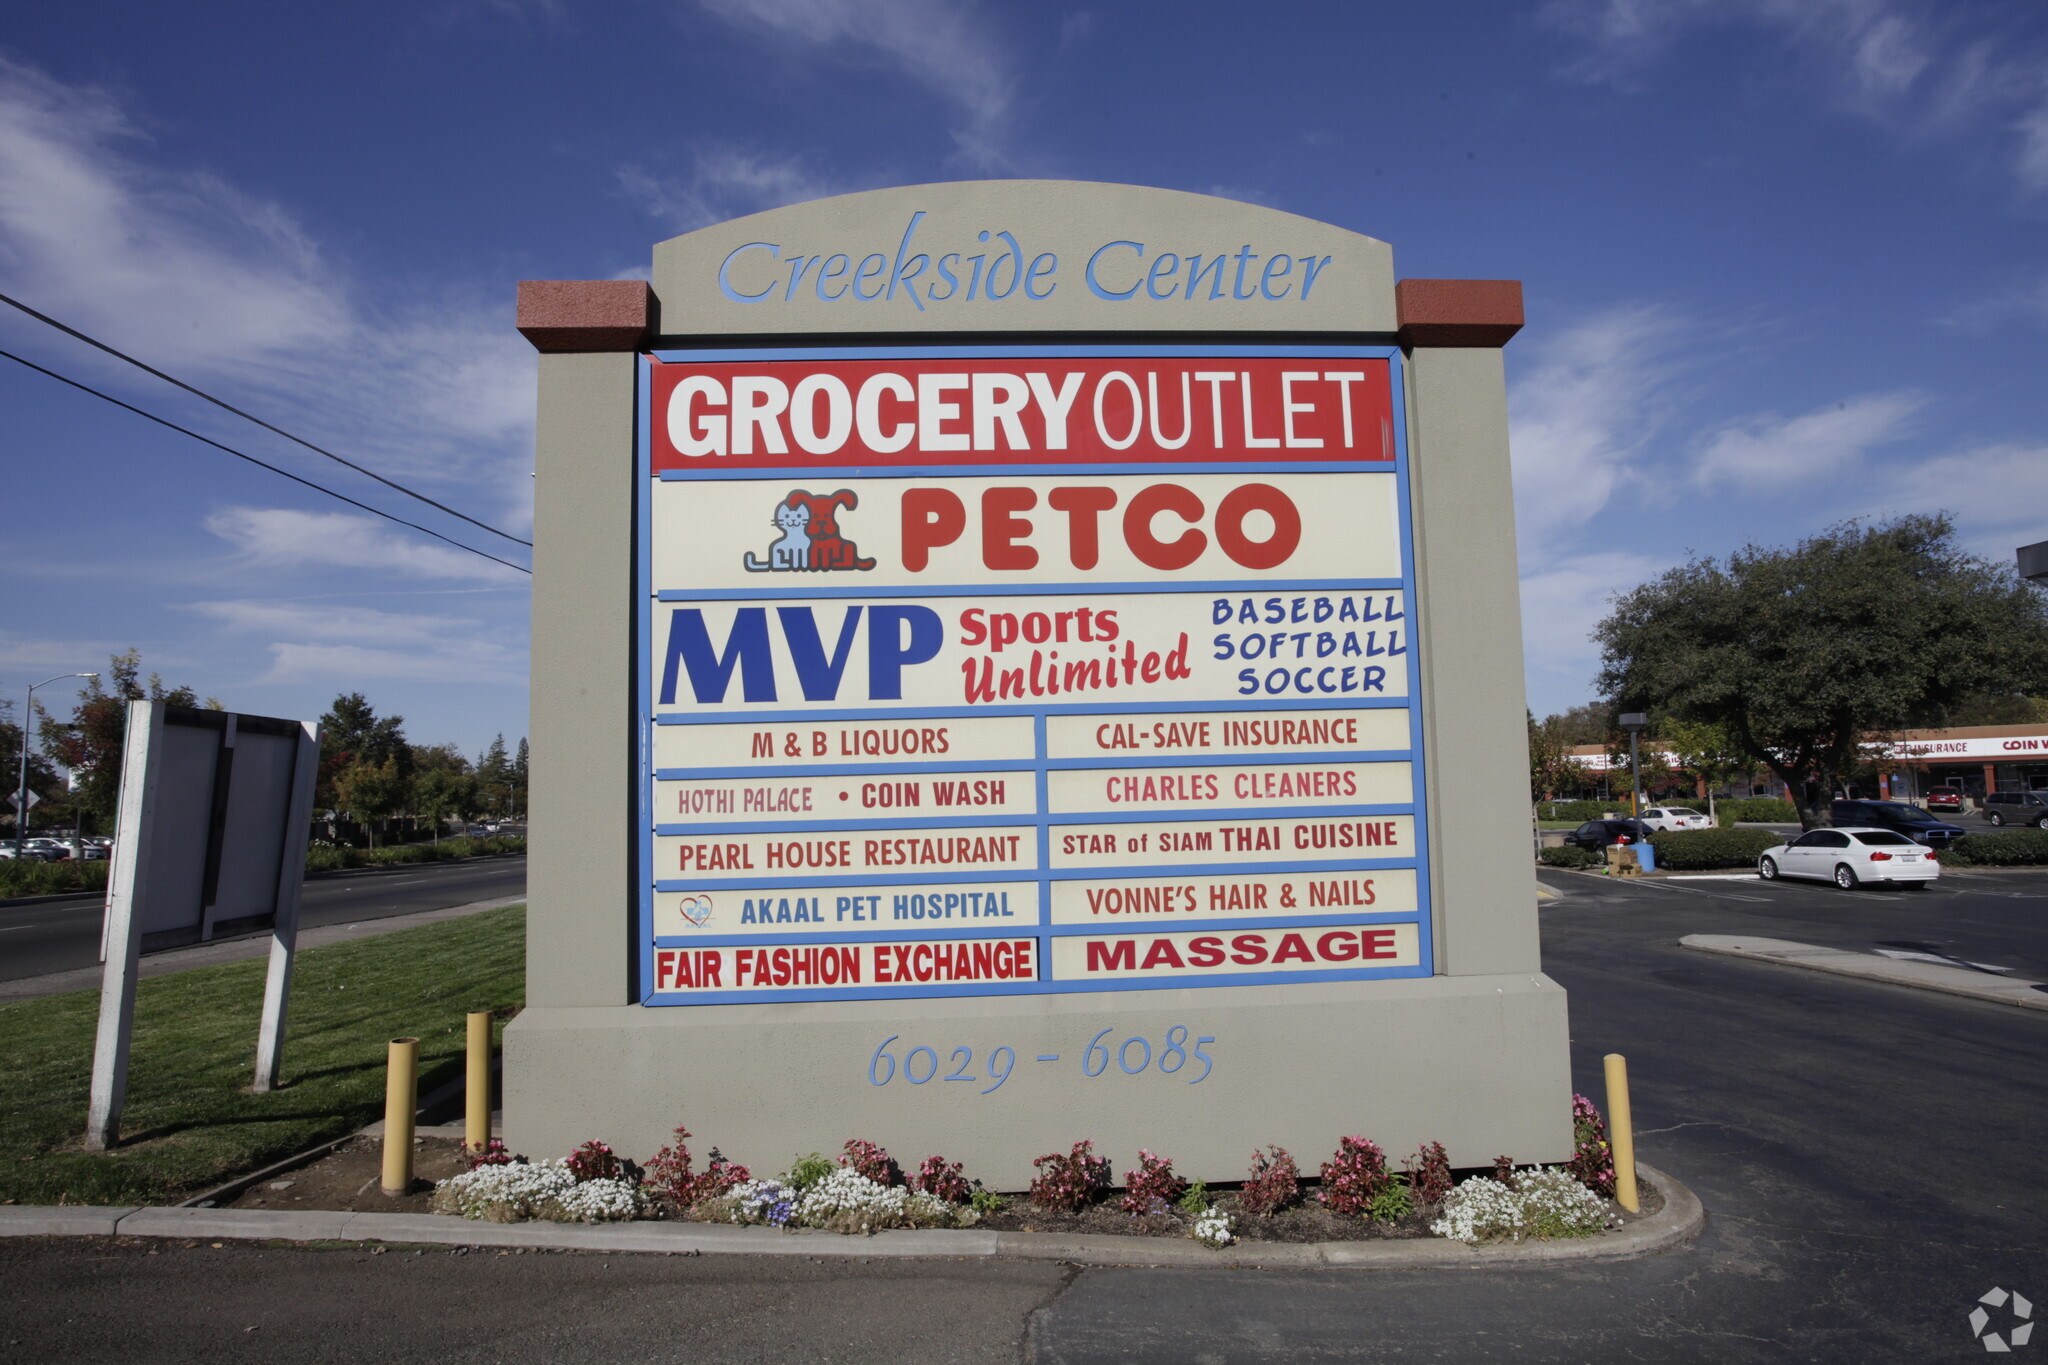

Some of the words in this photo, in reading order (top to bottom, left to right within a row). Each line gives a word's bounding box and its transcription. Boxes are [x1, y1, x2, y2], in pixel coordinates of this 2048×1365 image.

[718, 211, 1058, 311] Creekside
[1085, 241, 1332, 301] Center
[667, 372, 1085, 456] GROCERY
[1093, 370, 1365, 450] OUTLET
[900, 483, 1302, 573] PETCO
[1213, 595, 1405, 625] BASEBALL
[960, 607, 1120, 648] Sports
[1213, 629, 1406, 660] SOFTBALL
[659, 605, 944, 704] MVP
[961, 632, 1192, 701] Unlimited
[1238, 666, 1386, 695] SOCCER
[751, 732, 774, 758] M
[784, 732, 802, 757] &
[812, 731, 828, 756] B
[841, 728, 950, 756] LIQUORS
[1096, 722, 1211, 749] CAL-SAVE
[1224, 718, 1358, 746] INSURANCE
[1914, 742, 1968, 753] INSURANCE
[2003, 740, 2038, 750] COIN
[678, 788, 735, 814] HOTHI
[743, 787, 813, 813] PALACE
[861, 783, 920, 808] COIN
[933, 780, 1005, 806] WASH
[1106, 774, 1219, 802] CHARLES
[1234, 771, 1357, 799] CLEANERS
[679, 844, 754, 871] PEARL
[767, 841, 851, 868] HOUSE
[865, 836, 1020, 866] RESTAURANT
[1063, 835, 1117, 854] STAR
[1127, 834, 1148, 852] of
[1159, 832, 1213, 852] SIAM
[1219, 827, 1281, 851] THAI
[1294, 822, 1398, 849] CUISINE
[741, 898, 825, 924] AKAAL
[836, 896, 882, 921] PET
[893, 892, 1014, 920] HOSPITAL
[1086, 885, 1197, 914] VONNE'S
[1209, 884, 1268, 910] HAIR
[1279, 883, 1297, 908] &
[1309, 879, 1376, 907] NAILS
[657, 951, 722, 988] FAIR
[736, 947, 861, 986] FASHION
[874, 941, 1033, 983] EXCHANGE
[1086, 929, 1398, 971] MASSAGE
[868, 1034, 1015, 1094] 6029
[1082, 1024, 1215, 1084] 6085
